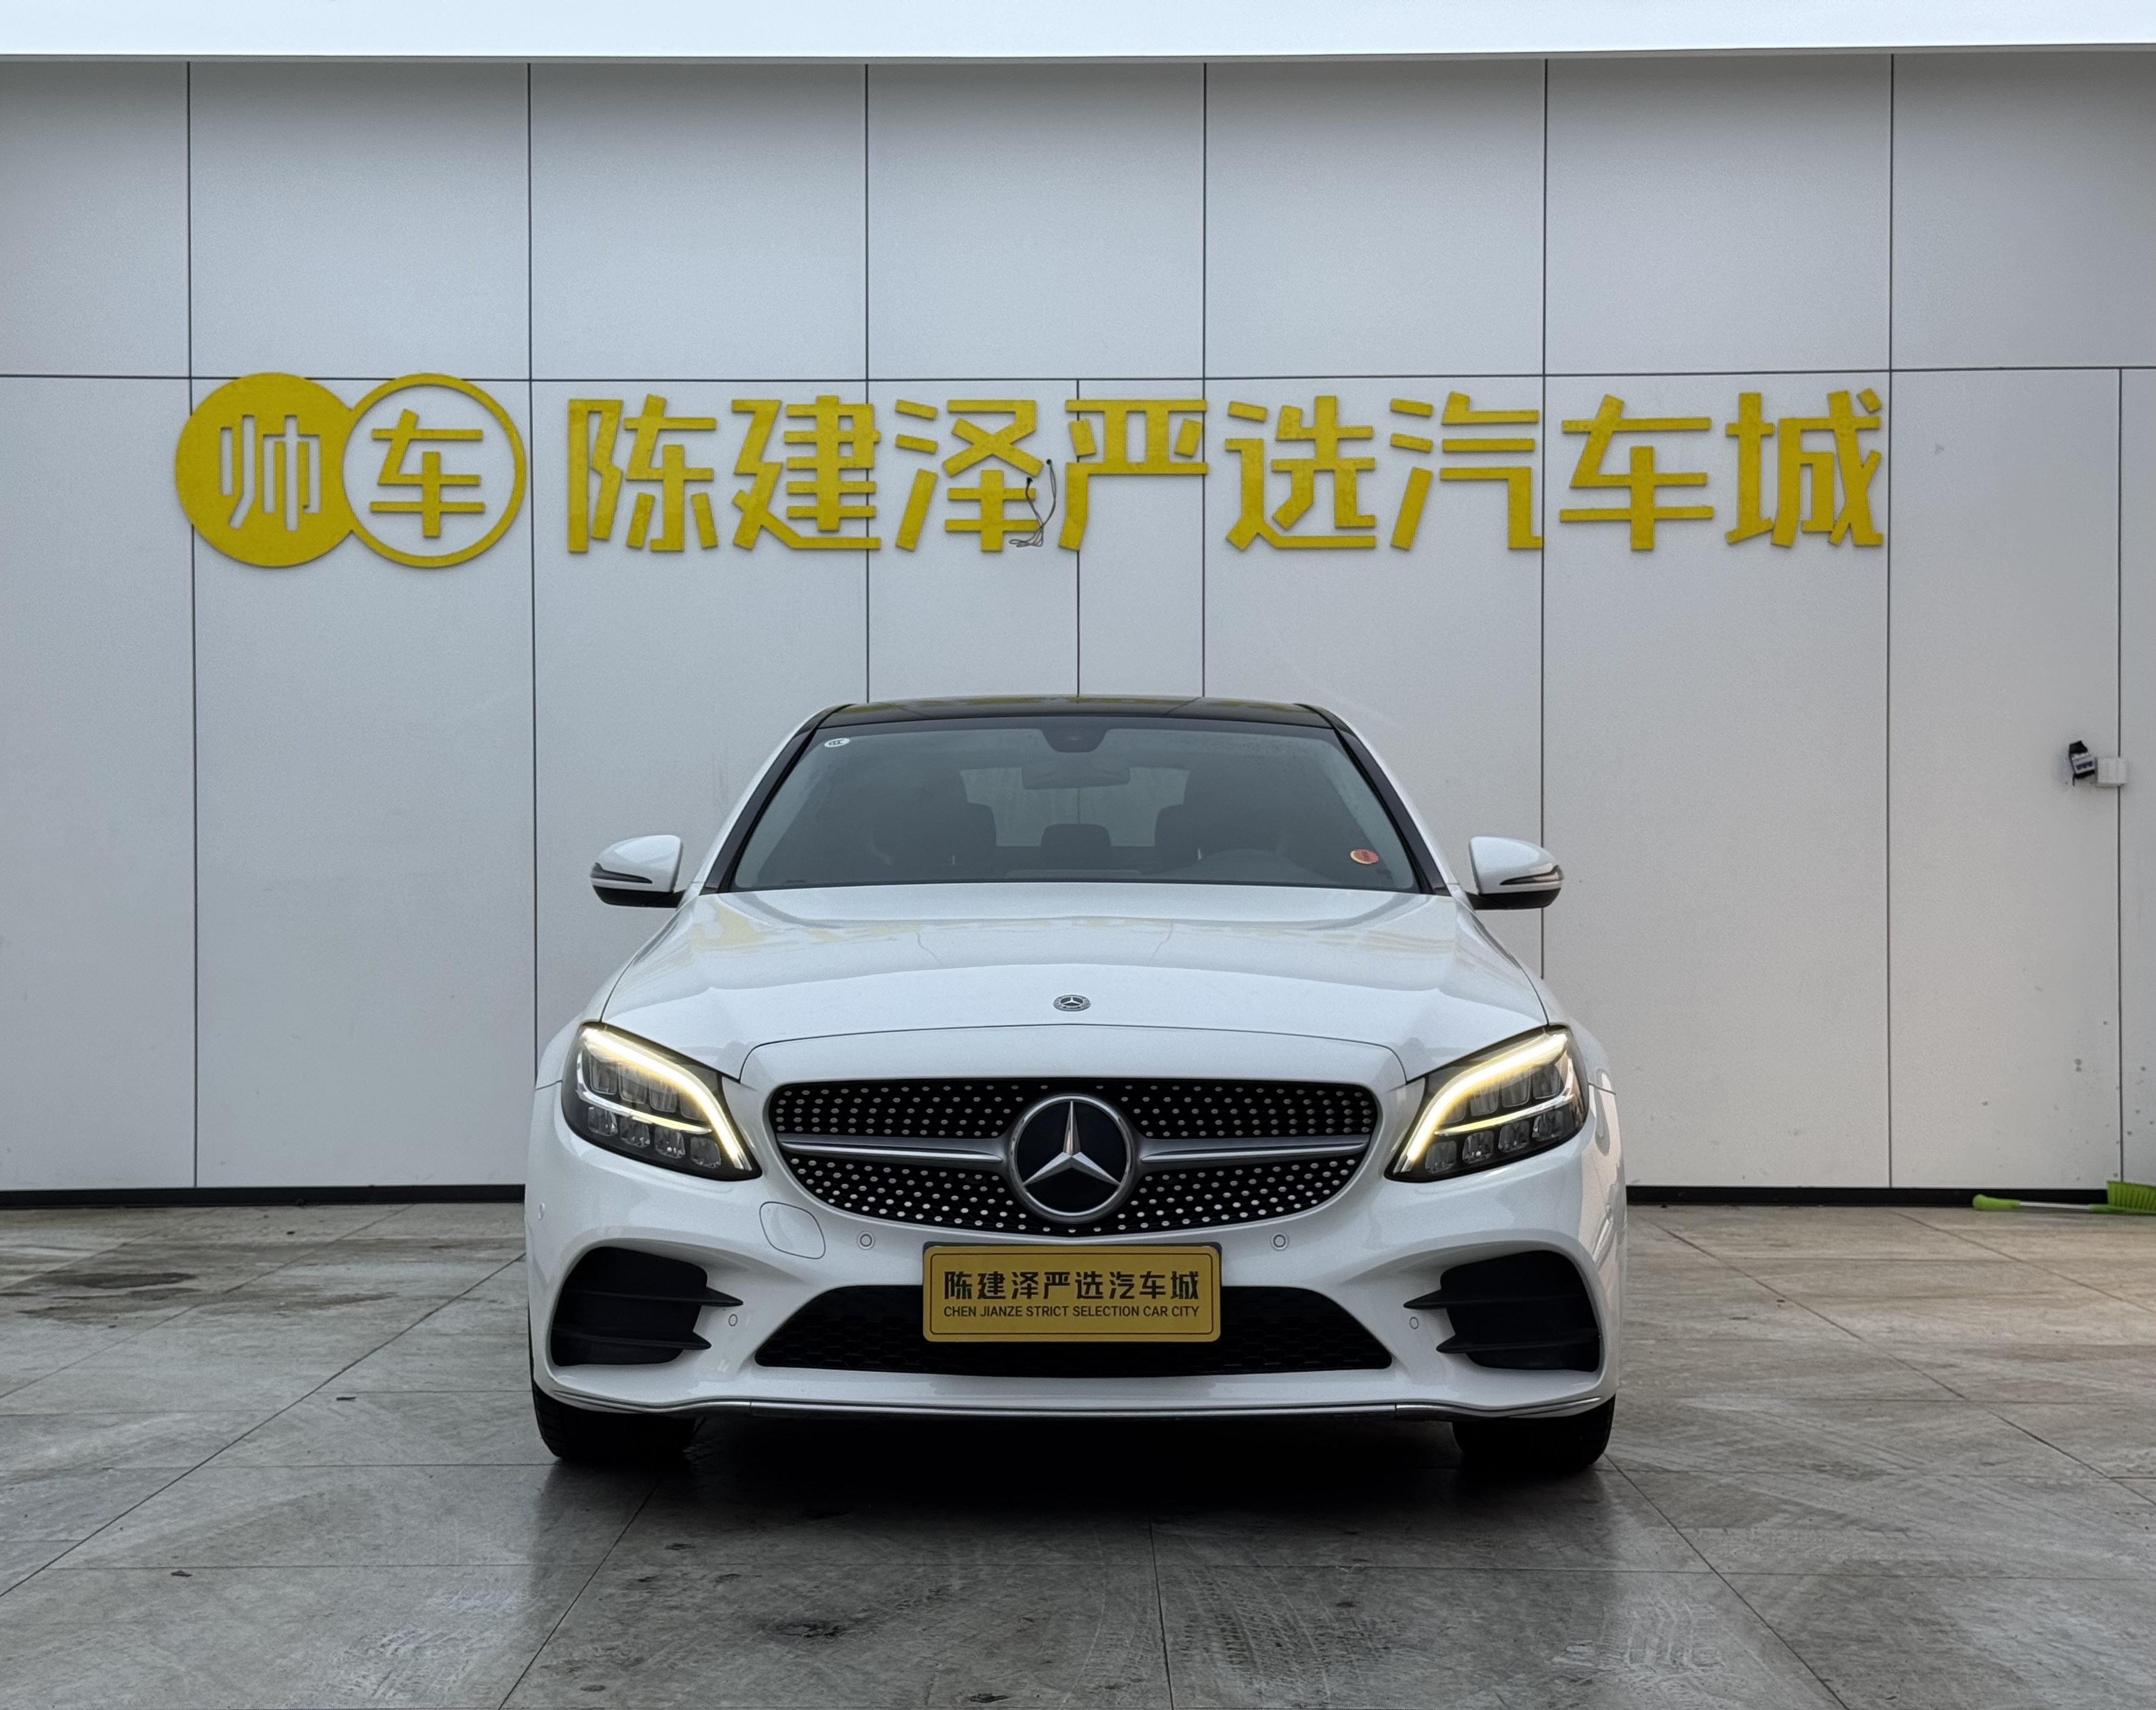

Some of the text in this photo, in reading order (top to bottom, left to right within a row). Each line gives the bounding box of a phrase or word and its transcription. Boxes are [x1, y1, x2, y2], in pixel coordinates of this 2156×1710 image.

[568, 389, 1883, 552] 陈建泽严选汽车城
[943, 1271, 1198, 1299] 陈建泽严选汽车城
[944, 1306, 1199, 1317] CHEN JIANZE STRICT SELECTION CAR CITY
